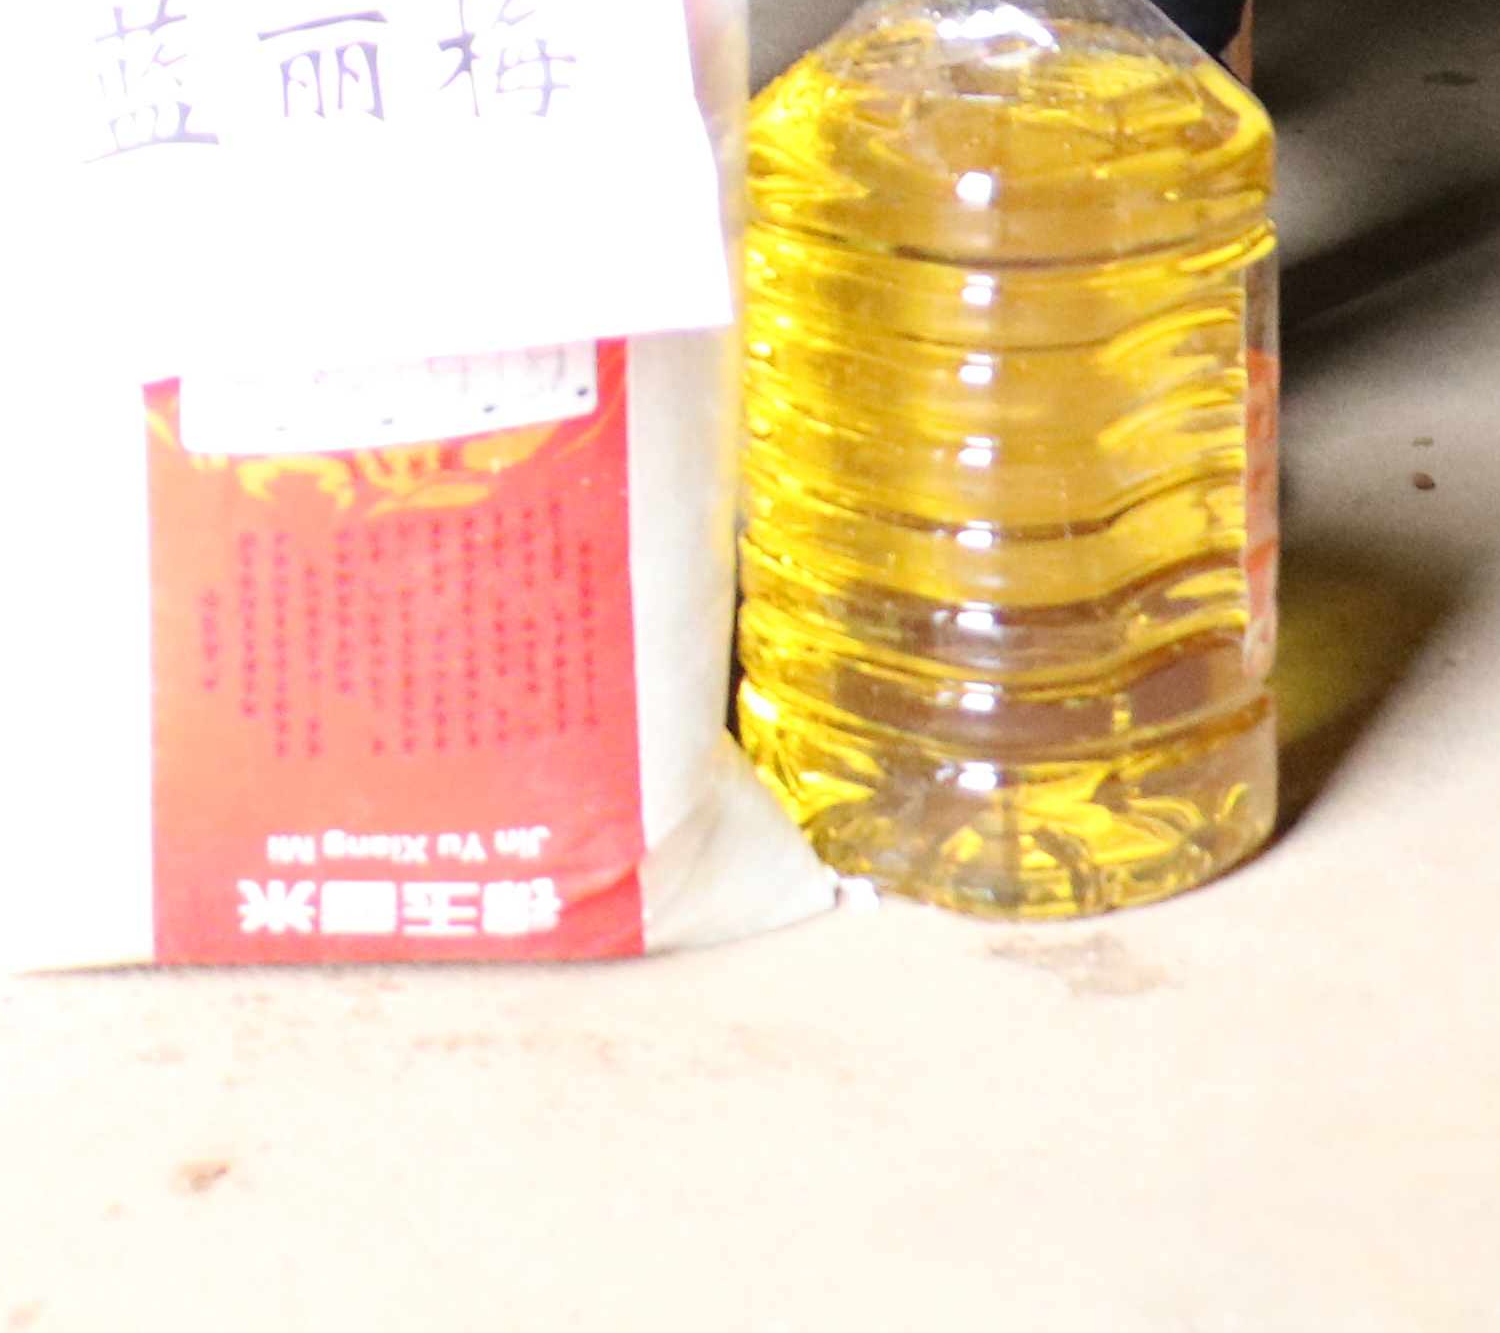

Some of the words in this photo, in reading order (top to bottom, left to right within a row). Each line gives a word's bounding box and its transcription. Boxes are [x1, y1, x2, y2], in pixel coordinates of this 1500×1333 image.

[266, 835, 316, 865] Mi
[322, 829, 429, 865] Xiang
[436, 832, 487, 862] Yu
[495, 825, 551, 859] Jin
[237, 877, 562, 934] 锦玉米
